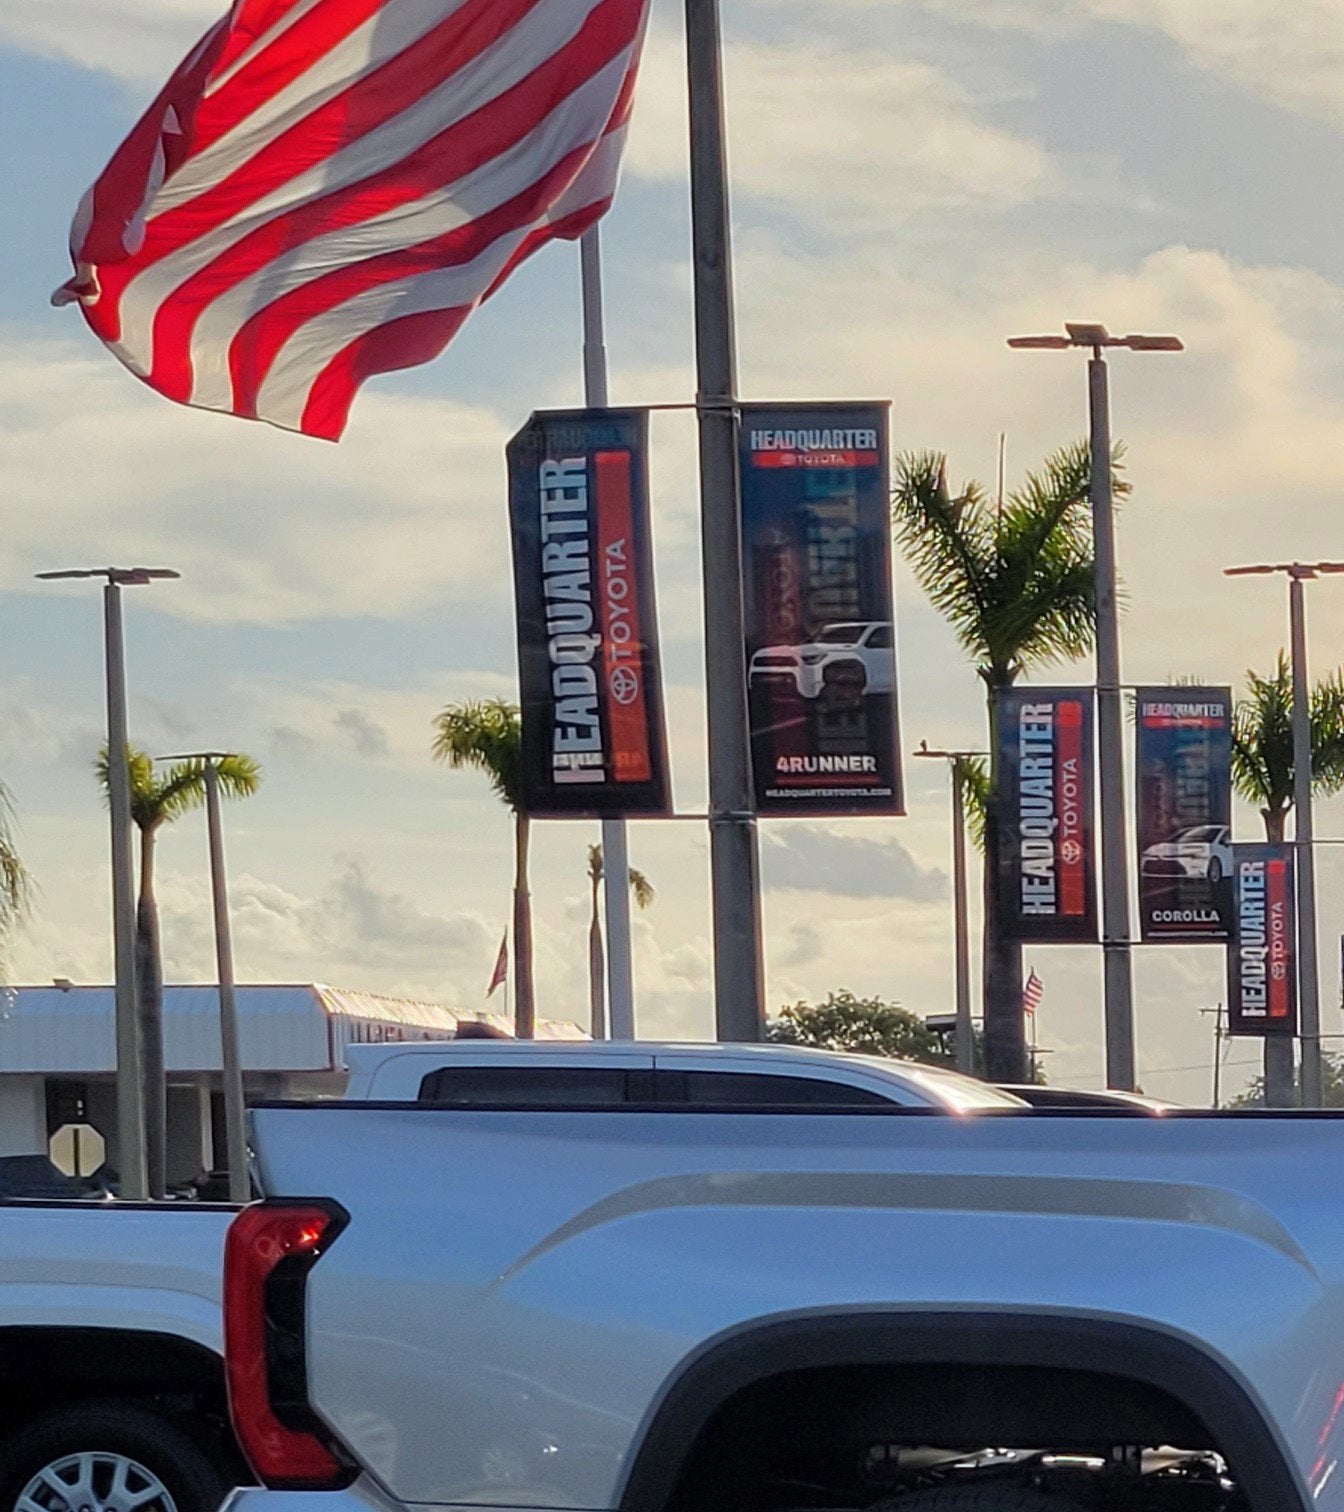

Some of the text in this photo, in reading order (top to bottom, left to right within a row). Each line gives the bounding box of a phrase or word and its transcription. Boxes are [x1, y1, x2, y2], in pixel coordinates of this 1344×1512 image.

[751, 429, 877, 452] HEADQUARTER
[539, 456, 606, 783] HEADQUARTER
[606, 538, 630, 662] TOYOTA
[776, 755, 877, 773] 4RUNNER
[1064, 758, 1078, 837] TOYOTA
[1019, 703, 1058, 915] HEADQUARTER
[1152, 910, 1220, 922] COROLLA
[1240, 862, 1268, 1017] HEADQUARTER
[1272, 902, 1284, 959] TOYOTA
